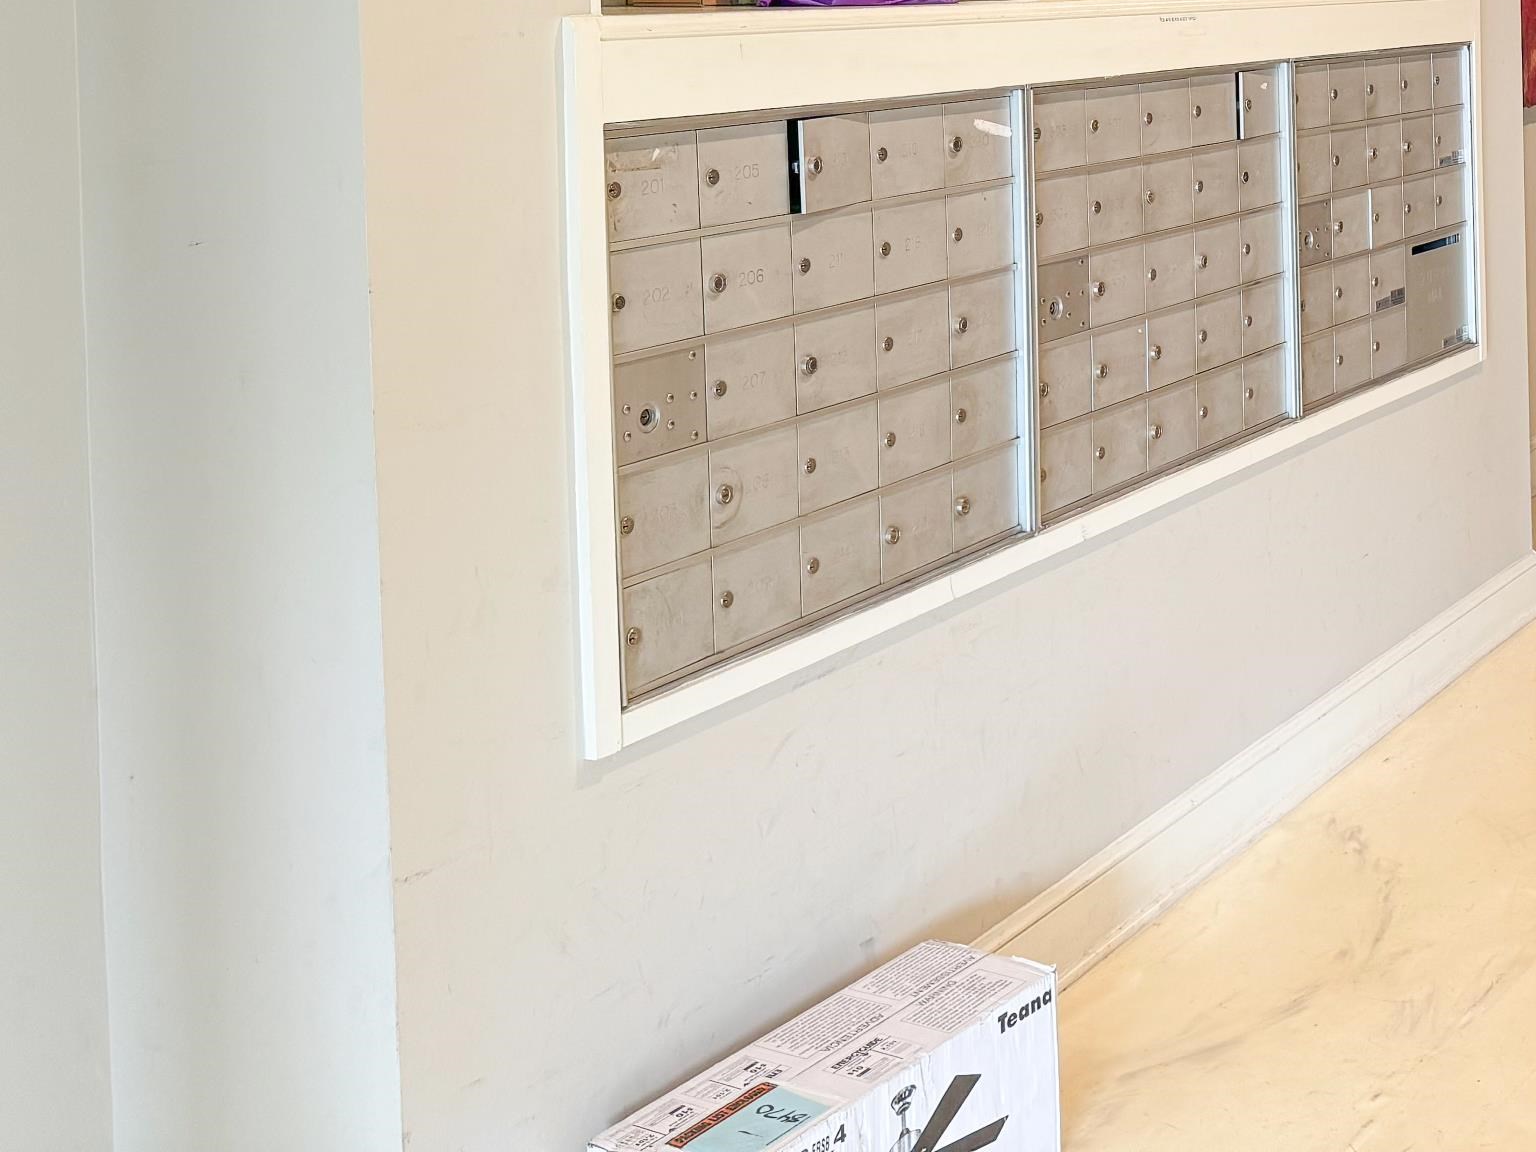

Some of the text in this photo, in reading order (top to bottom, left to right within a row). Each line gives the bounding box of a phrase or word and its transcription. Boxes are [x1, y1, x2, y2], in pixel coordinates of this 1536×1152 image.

[735, 163, 760, 181] 205
[641, 178, 664, 196] 201
[738, 268, 765, 287] 206
[643, 287, 670, 305] 202
[743, 371, 766, 390] 207
[833, 1123, 847, 1145] 4
